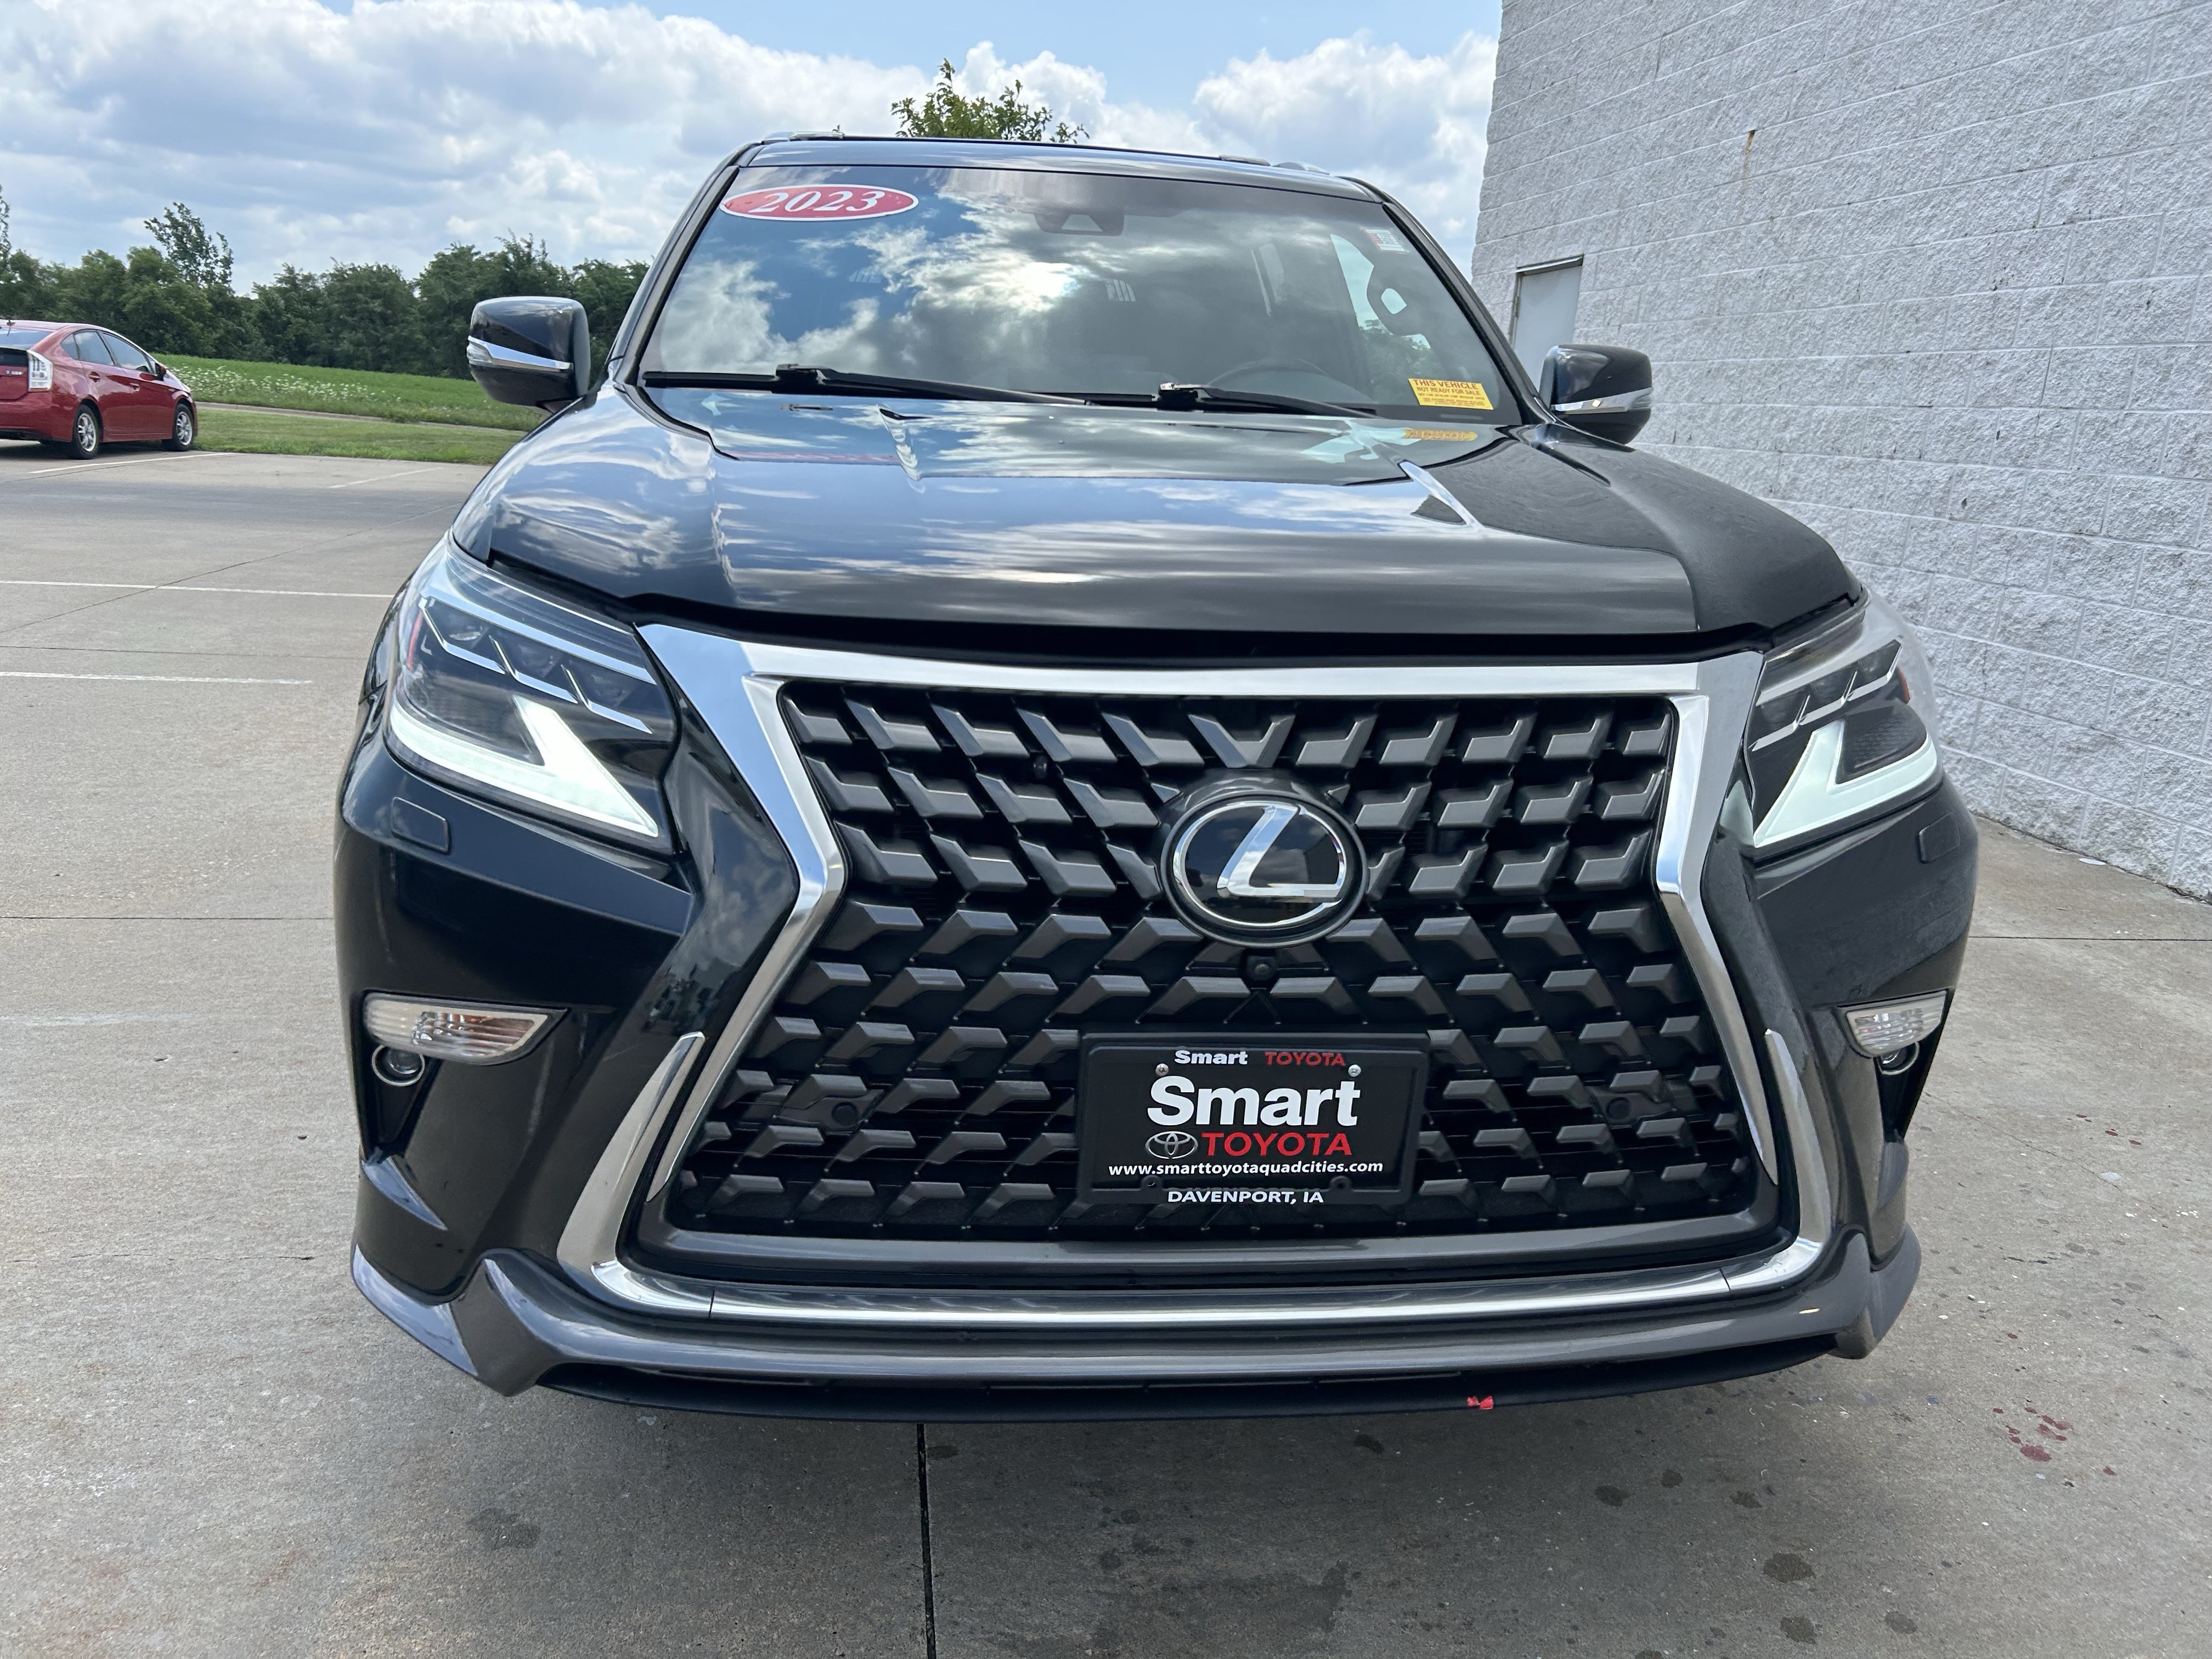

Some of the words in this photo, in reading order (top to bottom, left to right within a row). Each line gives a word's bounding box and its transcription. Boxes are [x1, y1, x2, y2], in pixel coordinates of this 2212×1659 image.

[748, 190, 885, 213] 2023
[1437, 381, 1479, 390] VEHICLE
[1174, 1050, 1248, 1065] Smart
[1265, 1052, 1346, 1066] TOYOTA
[1147, 1075, 1361, 1126] Smart
[1201, 1132, 1352, 1156] TOYOTA
[1108, 1160, 1384, 1177] www.smarttoyotaquadcities.com
[1167, 1190, 1296, 1205] DAVENPORT,
[1303, 1191, 1324, 1203] IA
